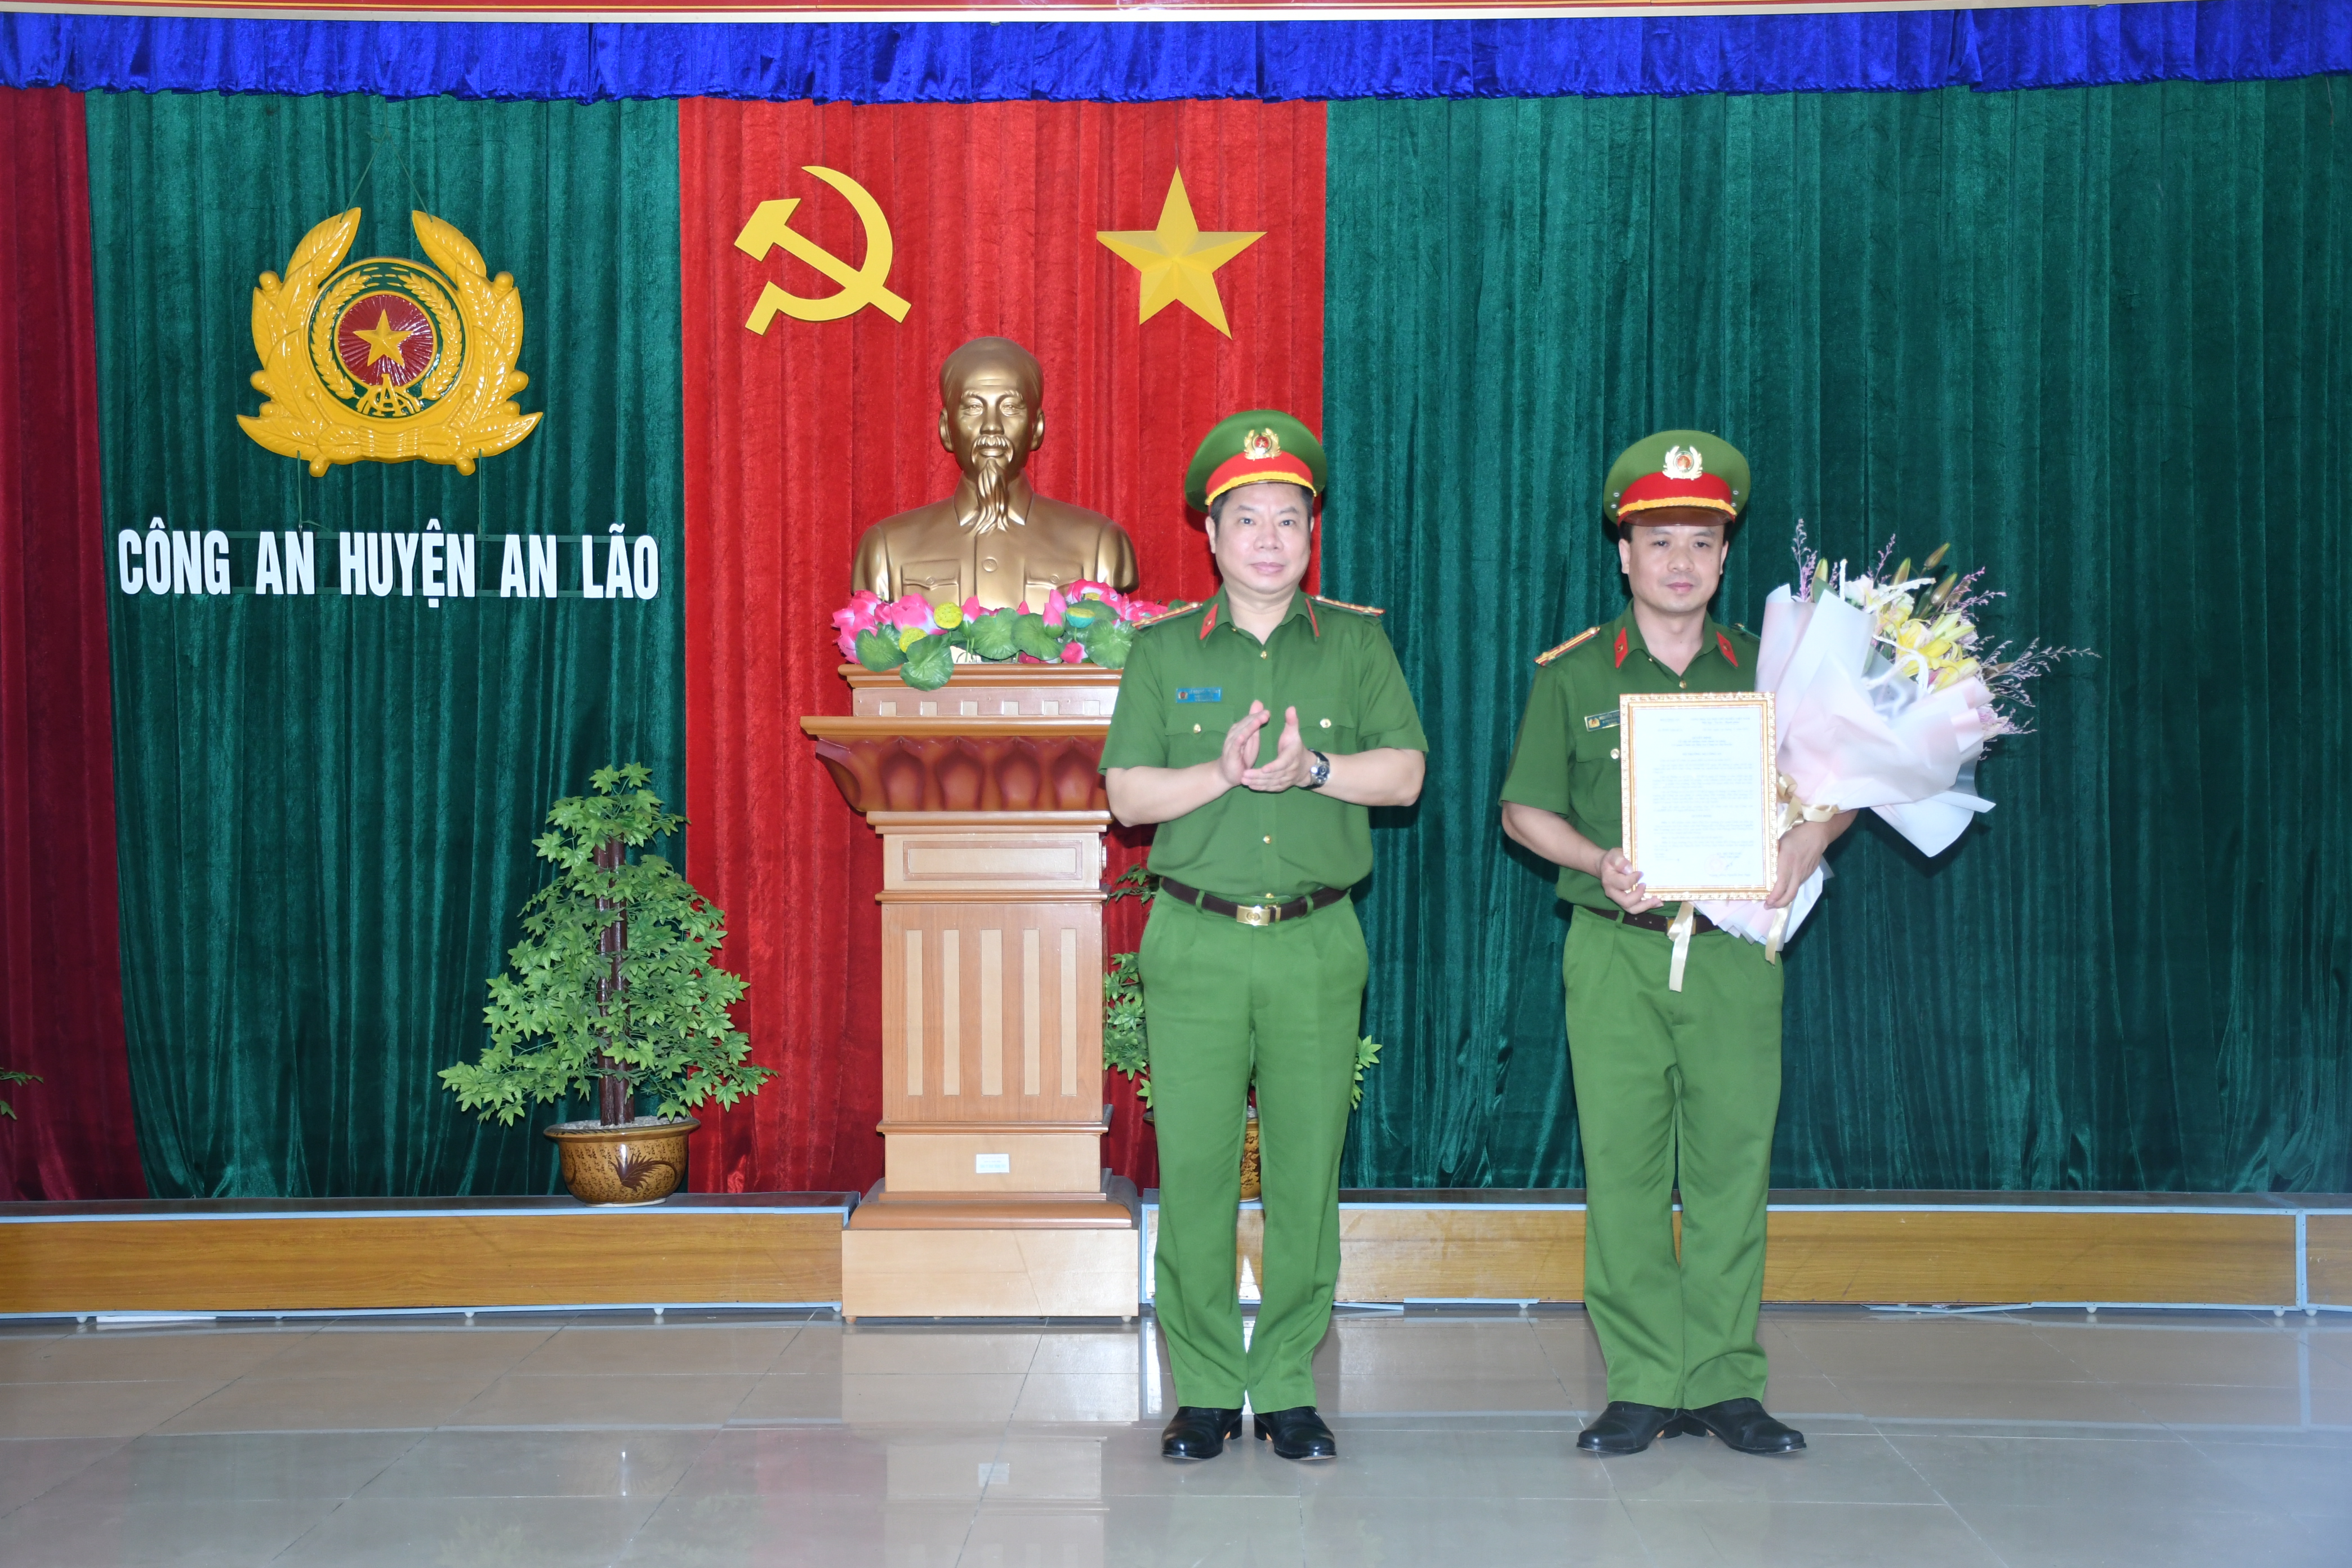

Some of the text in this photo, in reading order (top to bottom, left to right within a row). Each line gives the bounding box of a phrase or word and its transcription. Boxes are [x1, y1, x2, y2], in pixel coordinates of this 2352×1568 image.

[118, 516, 659, 608] CÔNG AN HUYỆN AN LÃO
